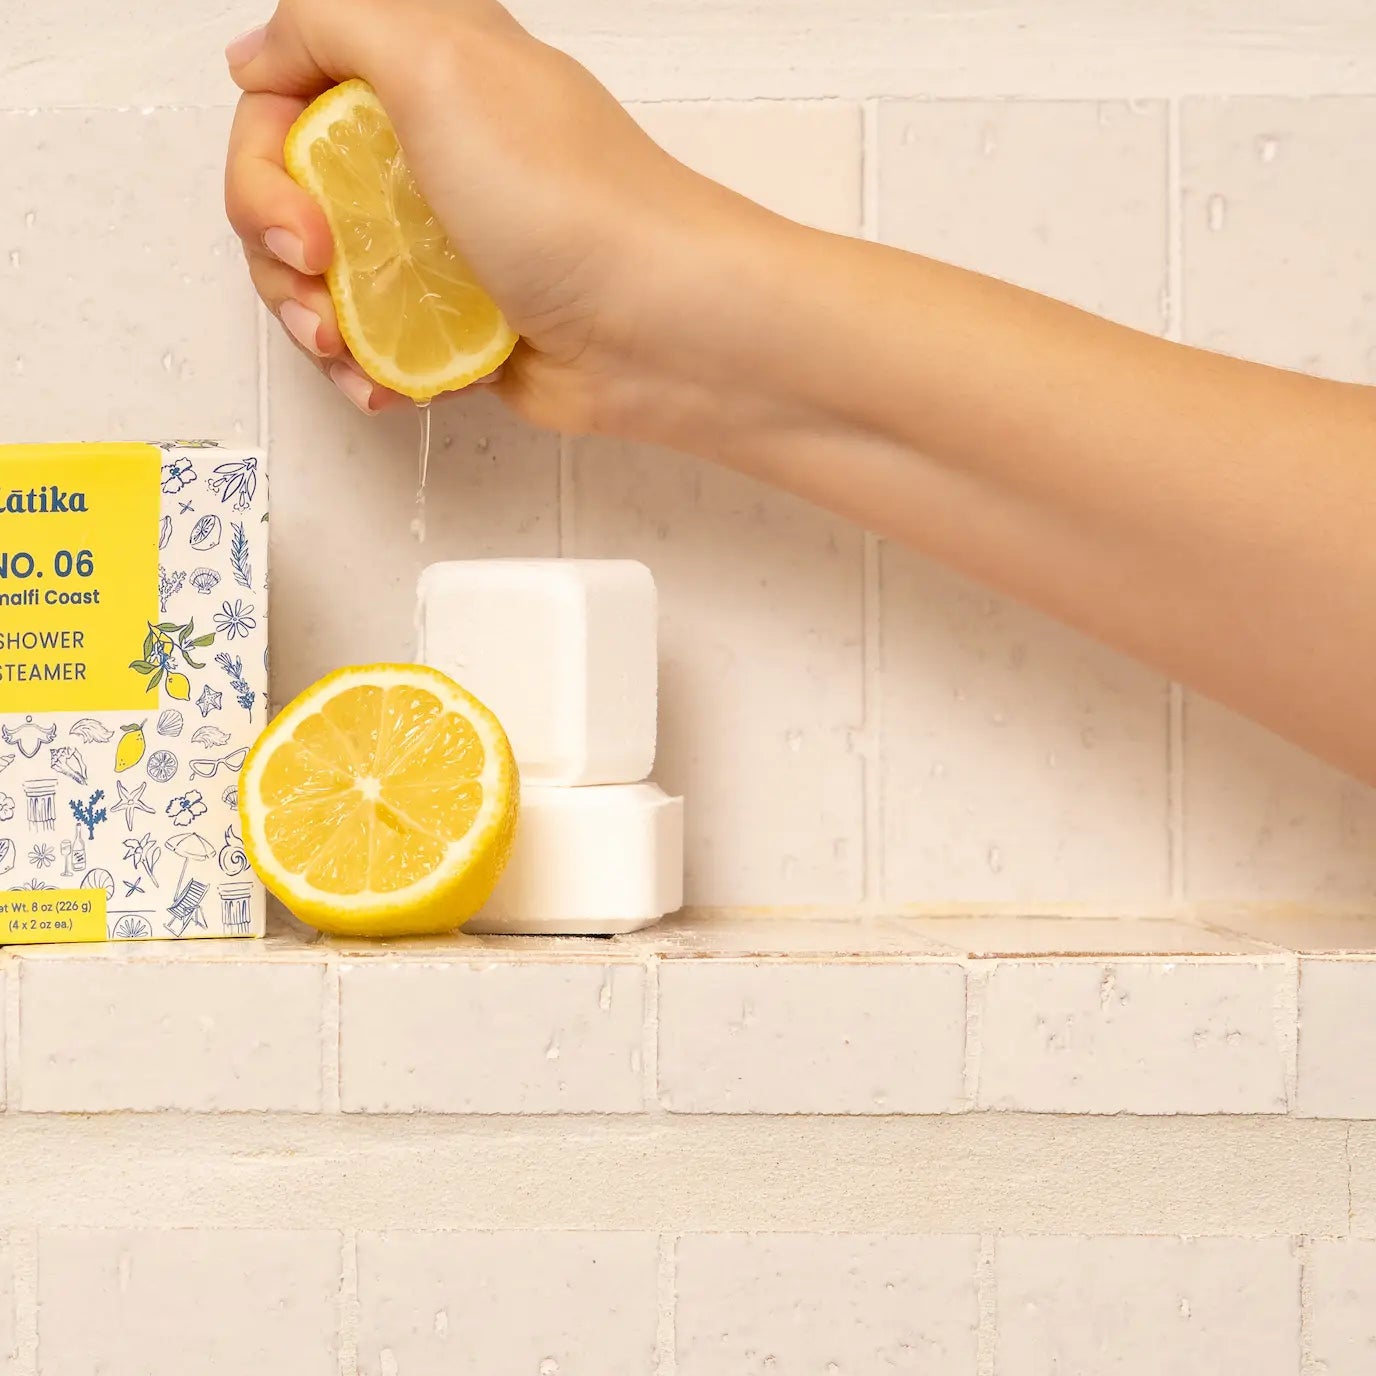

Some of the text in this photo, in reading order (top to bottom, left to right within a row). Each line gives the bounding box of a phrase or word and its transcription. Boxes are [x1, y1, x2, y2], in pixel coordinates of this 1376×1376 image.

[54, 549, 94, 578] 06
[45, 589, 100, 606] Coast
[11, 902, 29, 913] Wt.
[31, 902, 38, 912] 8
[41, 903, 53, 912] oz
[55, 901, 79, 914] (226
[81, 900, 92, 913] g)
[8, 919, 73, 932] (4 x 2 oz ea.)
